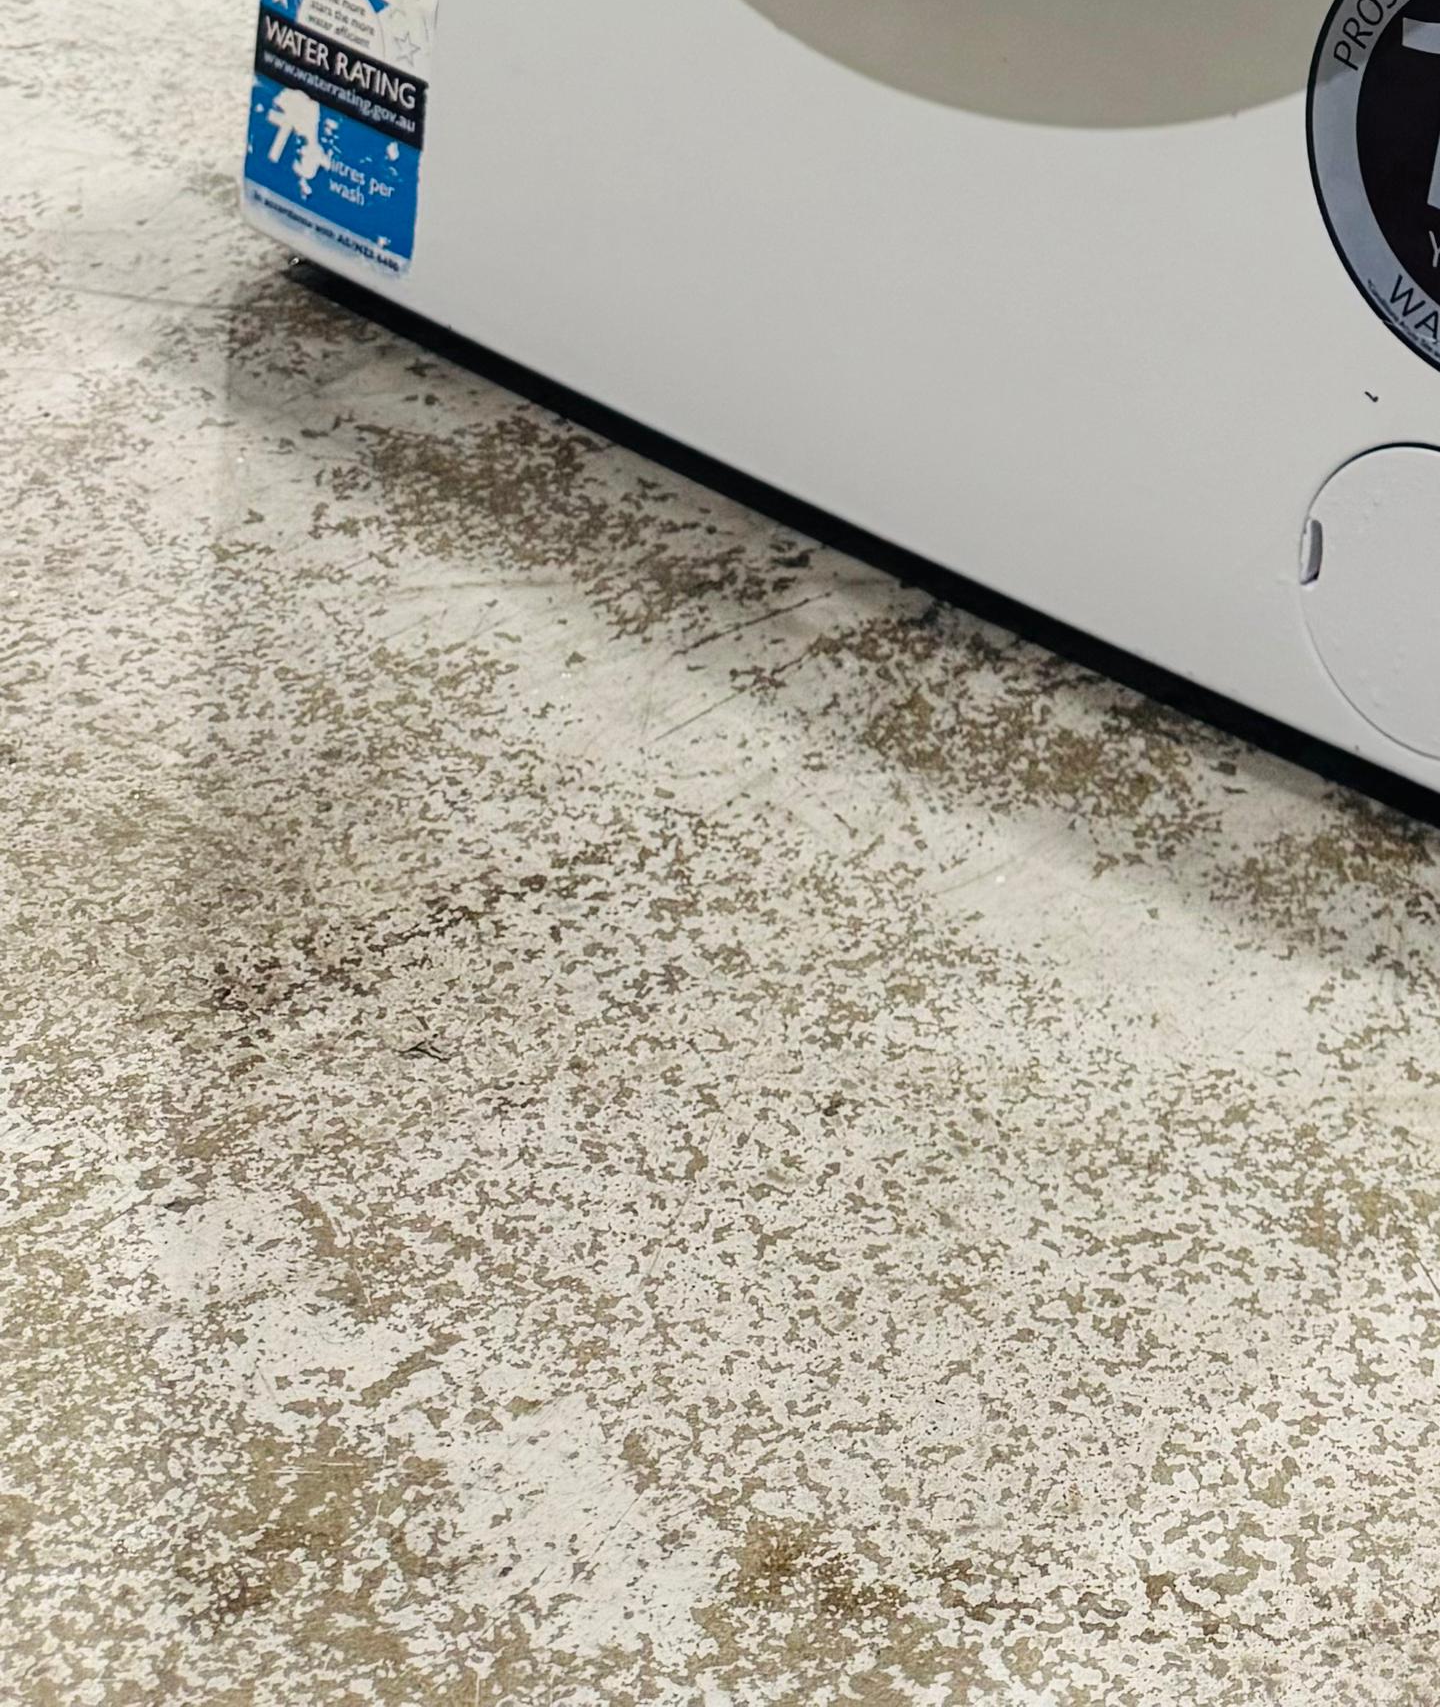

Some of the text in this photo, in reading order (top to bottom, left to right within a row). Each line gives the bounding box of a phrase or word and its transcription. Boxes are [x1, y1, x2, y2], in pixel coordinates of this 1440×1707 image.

[264, 14, 417, 110] WATER RATING
[328, 177, 366, 207] wash
[368, 177, 396, 199] per
